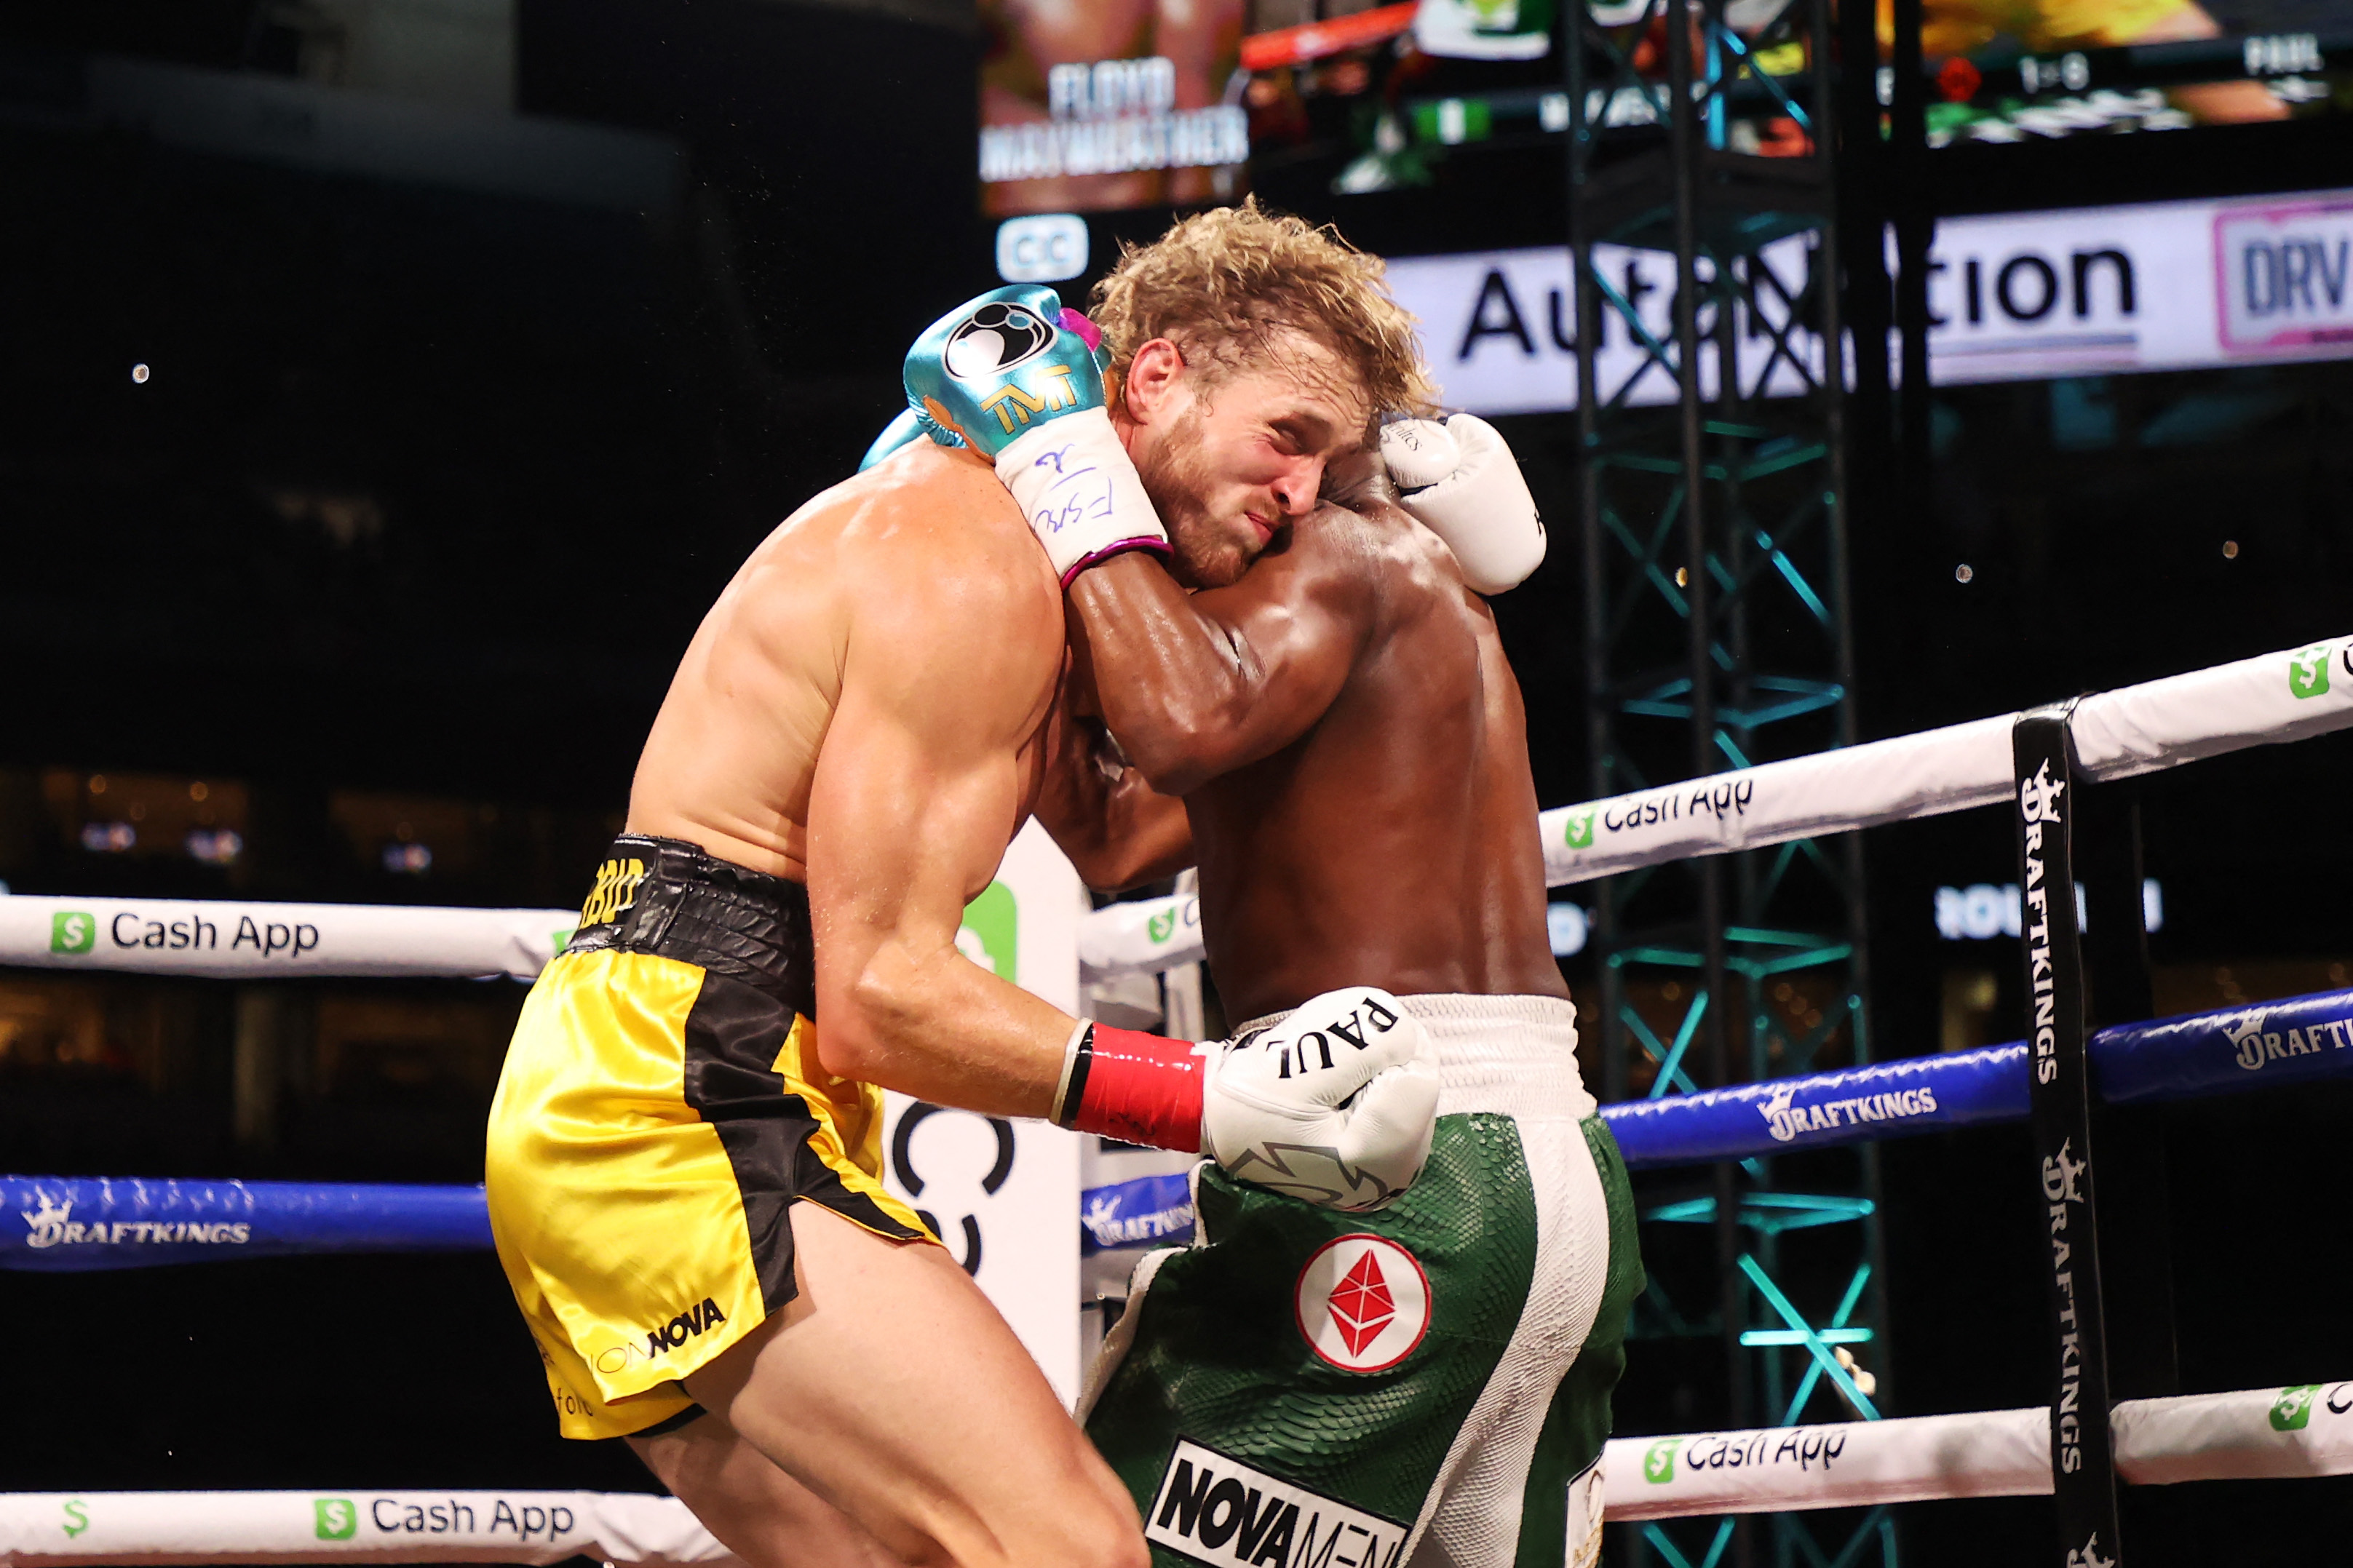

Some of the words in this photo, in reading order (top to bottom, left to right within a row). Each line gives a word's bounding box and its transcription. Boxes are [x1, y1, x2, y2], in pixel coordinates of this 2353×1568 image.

[1605, 793, 1679, 832] Cash
[1689, 778, 1754, 820] App
[111, 912, 217, 950] Cash
[231, 915, 320, 958] App
[2020, 777, 2058, 1086] DRAFTKINGS
[1265, 997, 1399, 1079] PAUL
[1768, 1086, 1938, 1142] DRAFTKINGS
[26, 1221, 251, 1249] DRAFTKINGS
[2041, 1155, 2082, 1475] DRAFTKINGS
[1686, 1431, 1768, 1471] Cash
[1774, 1428, 1849, 1472] App
[370, 1497, 475, 1534] Cash
[489, 1500, 575, 1543] App
